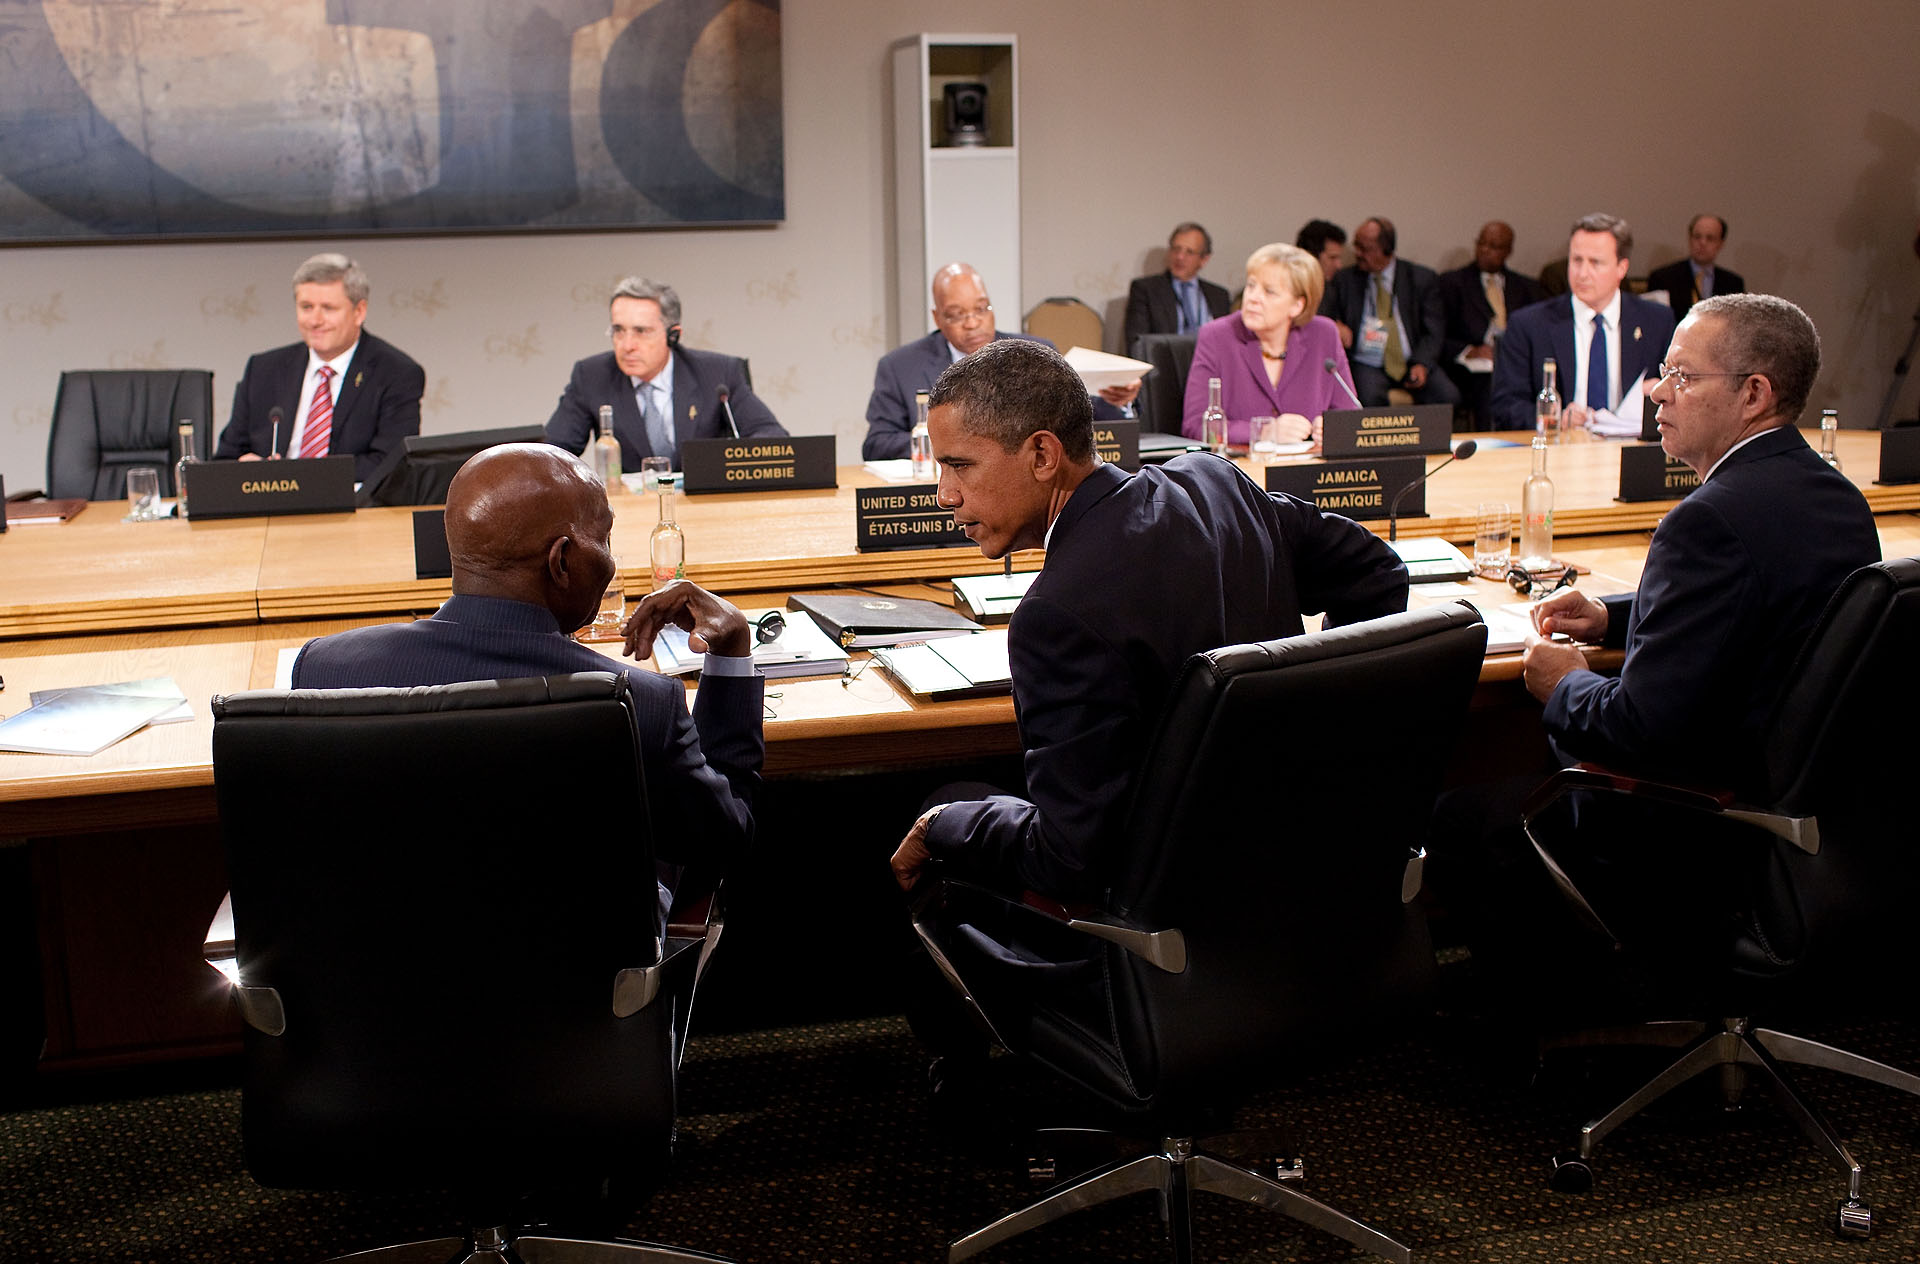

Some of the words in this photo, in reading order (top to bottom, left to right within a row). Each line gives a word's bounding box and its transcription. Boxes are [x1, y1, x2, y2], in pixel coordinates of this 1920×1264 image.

[1361, 415, 1415, 429] GERMANY
[1093, 429, 1115, 442] ICA
[1356, 433, 1420, 448] ALLEMAGNE
[724, 445, 795, 459] COLOMBIA
[725, 467, 795, 481] COLOMBIE
[1316, 469, 1379, 485] JAMAICA
[1665, 473, 1701, 488] ÉTHIO
[241, 480, 299, 494] CANADA
[861, 496, 906, 510] UNITED
[909, 494, 938, 507] STAT
[868, 521, 942, 536] ÉTATS-UNIS
